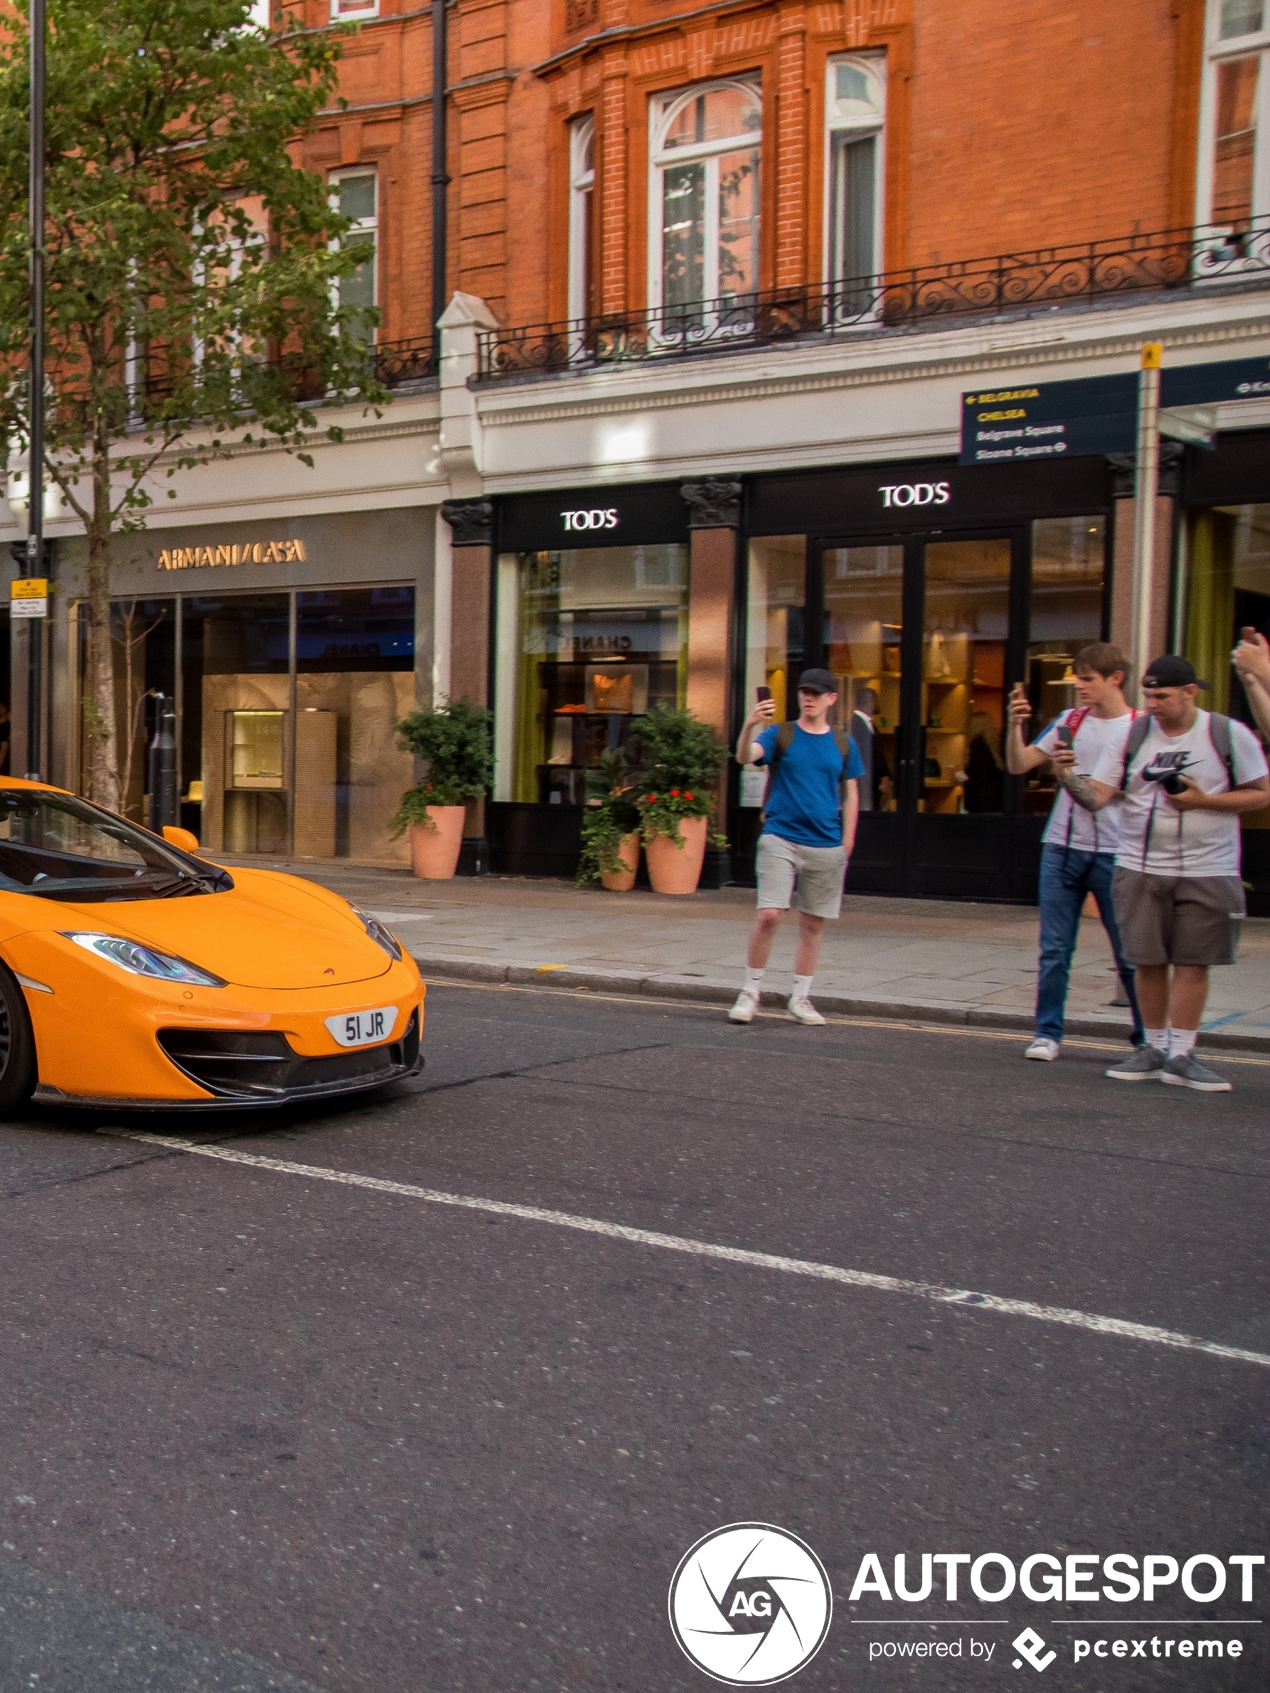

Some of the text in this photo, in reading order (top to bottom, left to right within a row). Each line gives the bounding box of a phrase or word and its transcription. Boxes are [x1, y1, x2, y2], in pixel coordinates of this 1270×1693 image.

[978, 388, 1040, 404] BELGRAVIA
[977, 408, 1027, 422] CHELSEA
[976, 424, 1065, 441] Belgrave Square
[976, 445, 1054, 460] Sloane Square
[1150, 751, 1191, 769] NIKE
[366, 1012, 384, 1038] JR
